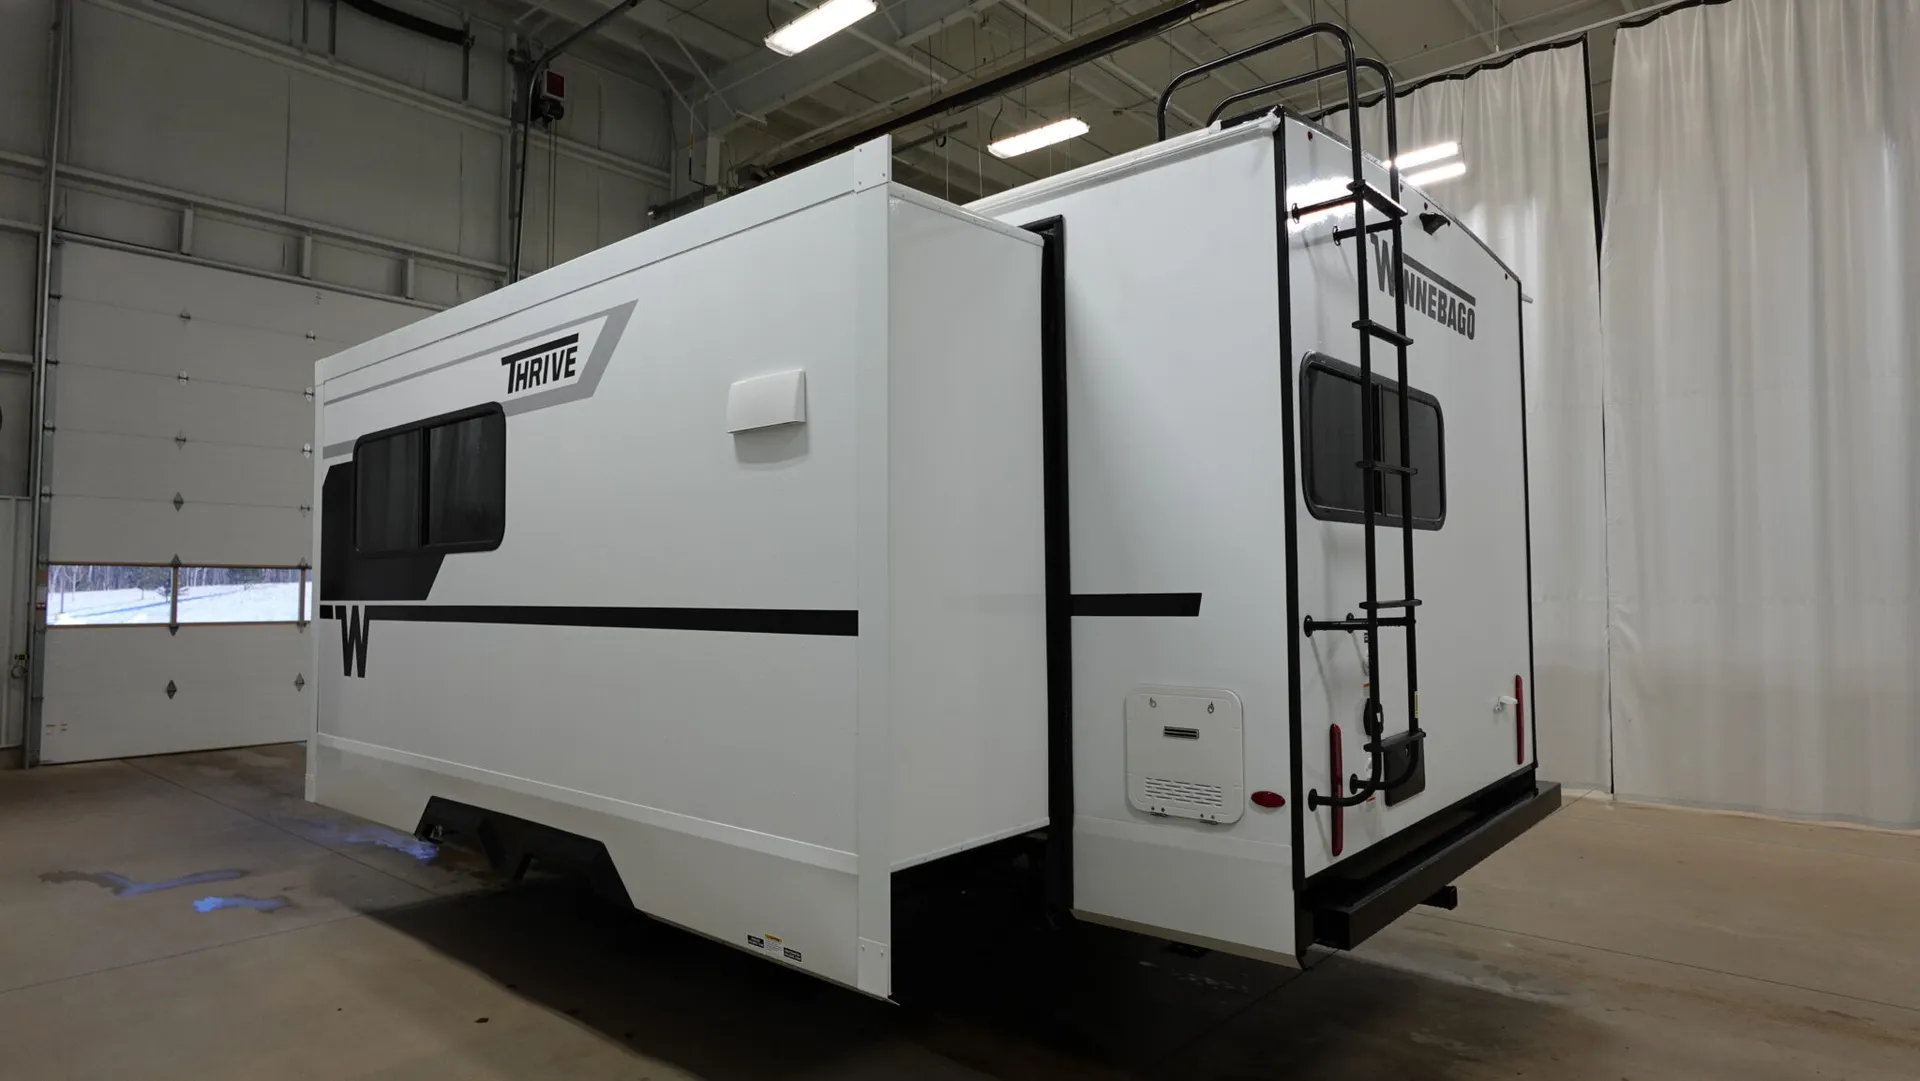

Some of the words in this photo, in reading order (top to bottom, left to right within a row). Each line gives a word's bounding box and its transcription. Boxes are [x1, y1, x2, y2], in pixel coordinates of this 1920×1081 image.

[1370, 232, 1476, 340] WNNEBAGO
[501, 332, 579, 394] THRIVE
[335, 605, 370, 678] W
